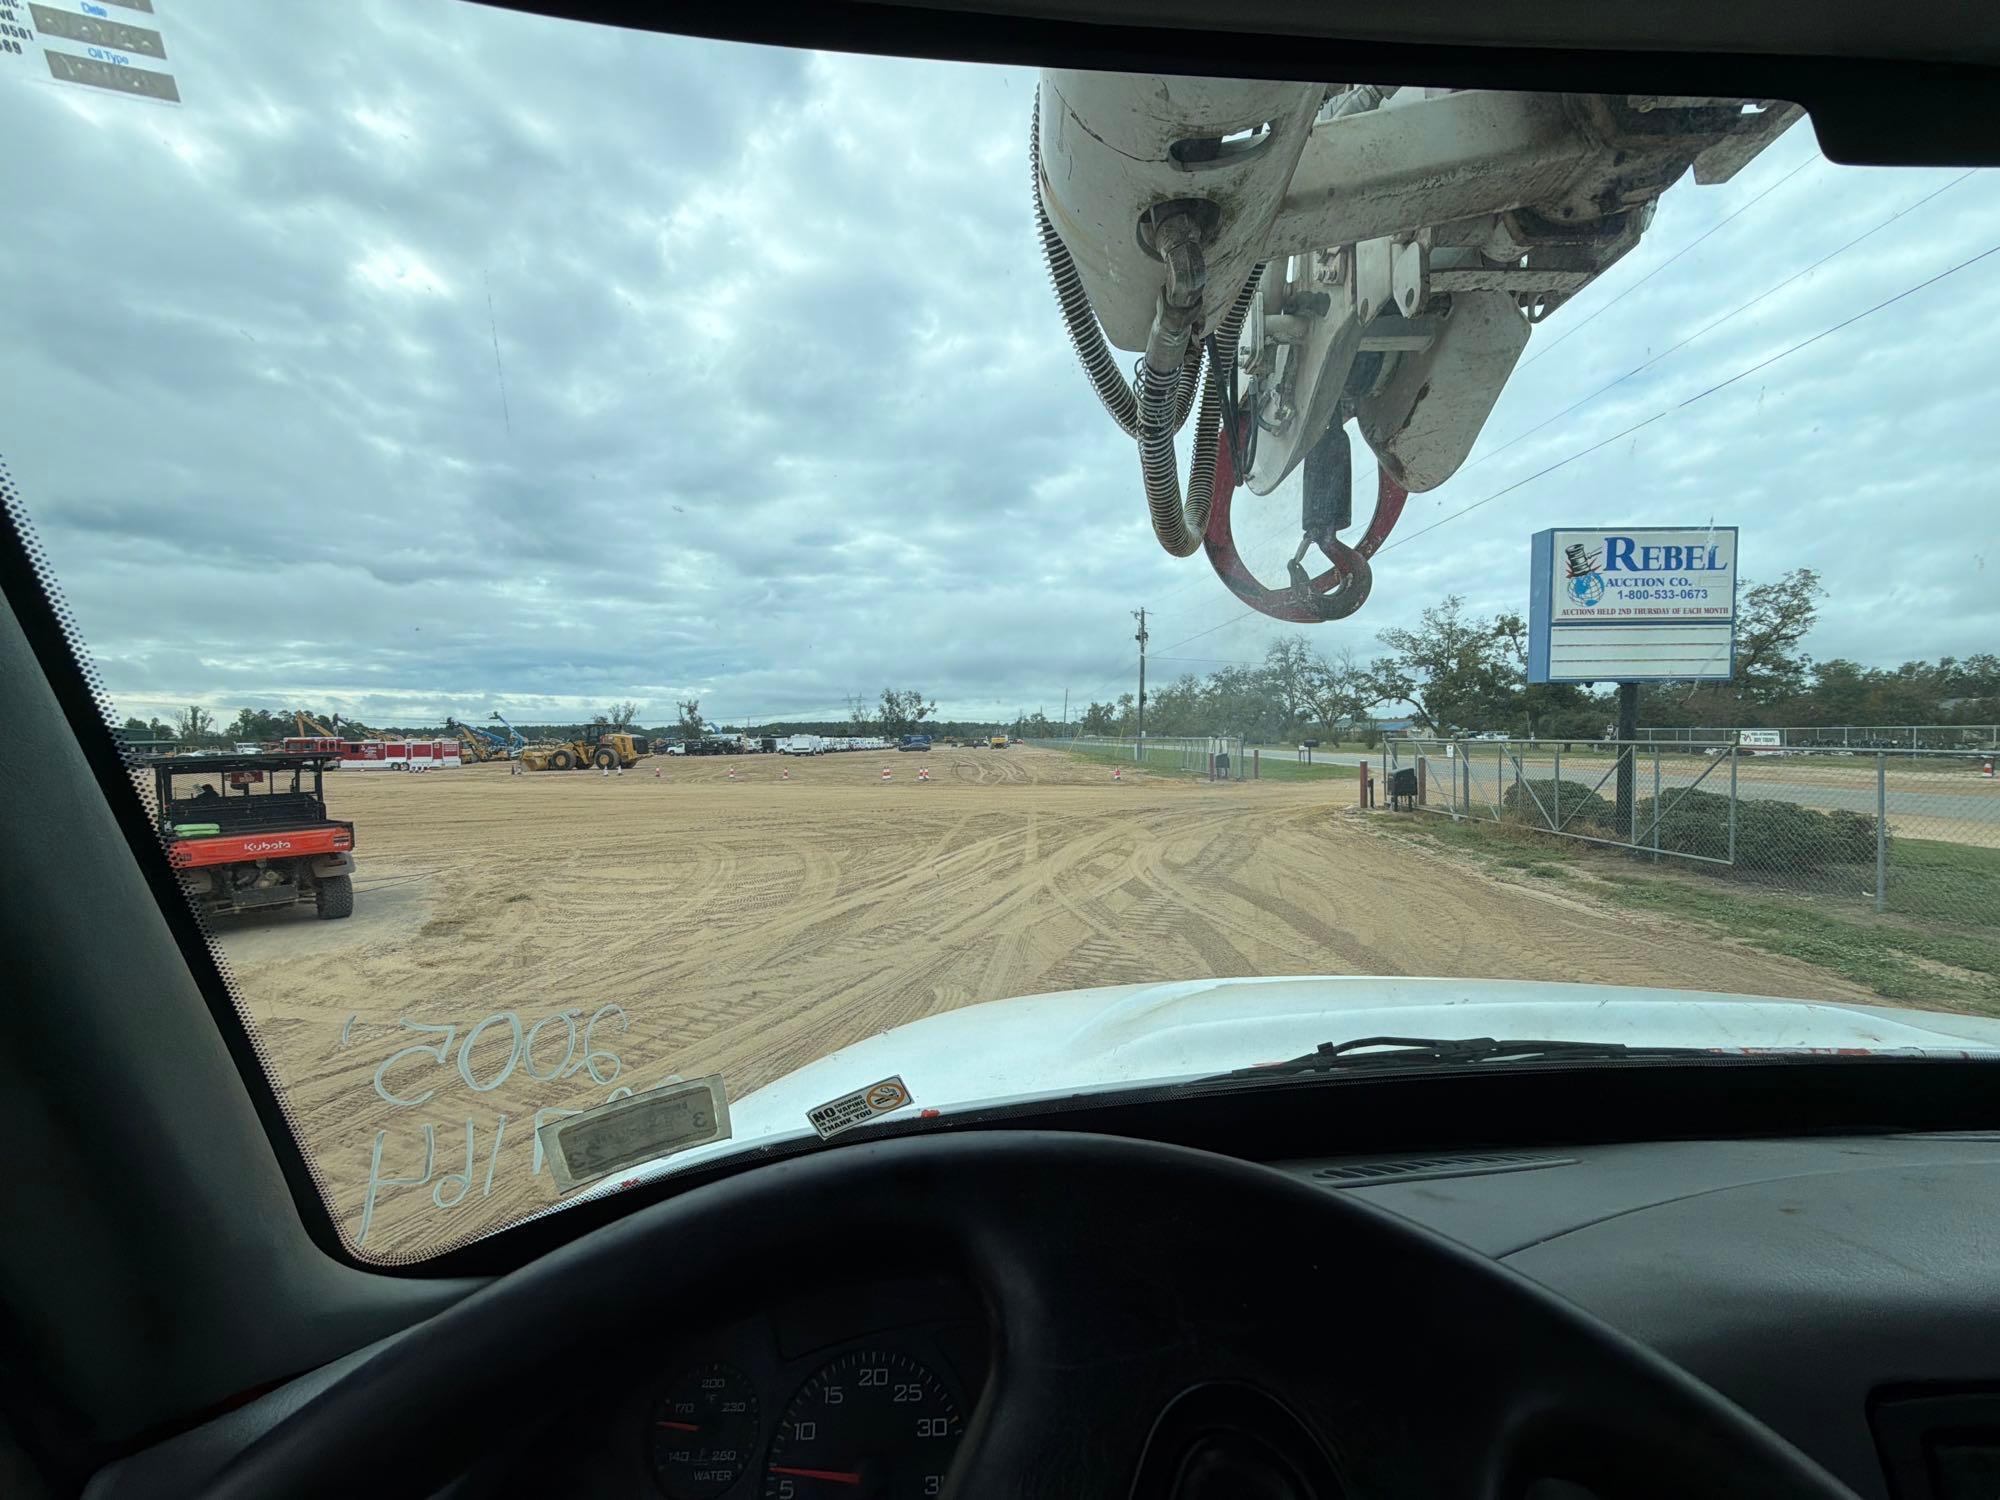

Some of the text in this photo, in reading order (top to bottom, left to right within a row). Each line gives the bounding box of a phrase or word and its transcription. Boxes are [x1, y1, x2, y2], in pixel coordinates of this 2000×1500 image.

[80, 2, 107, 17] Date
[0, 23, 34, 41] 0501
[88, 48, 129, 65] Oil Type
[1603, 536, 1728, 572] REBEL
[1605, 577, 1692, 588] AUCTION CO.
[1617, 589, 1708, 600] 1-800-533-0673
[244, 840, 291, 852] Kubota
[834, 1094, 862, 1109] SMOKING
[836, 1099, 866, 1113] VAPING
[812, 1107, 836, 1123] NO
[822, 1109, 872, 1133] THANK YOU
[827, 1115, 841, 1124] THIS
[842, 1105, 869, 1117] VEHICLE
[701, 1378, 725, 1389] 200
[858, 1369, 888, 1386] 20
[824, 1386, 843, 1404] 15
[893, 1384, 923, 1402] 25
[720, 1401, 746, 1412] 230
[794, 1422, 816, 1440] 10
[917, 1418, 948, 1437] 30
[693, 1469, 733, 1481] WATER
[779, 1480, 794, 1500] 5
